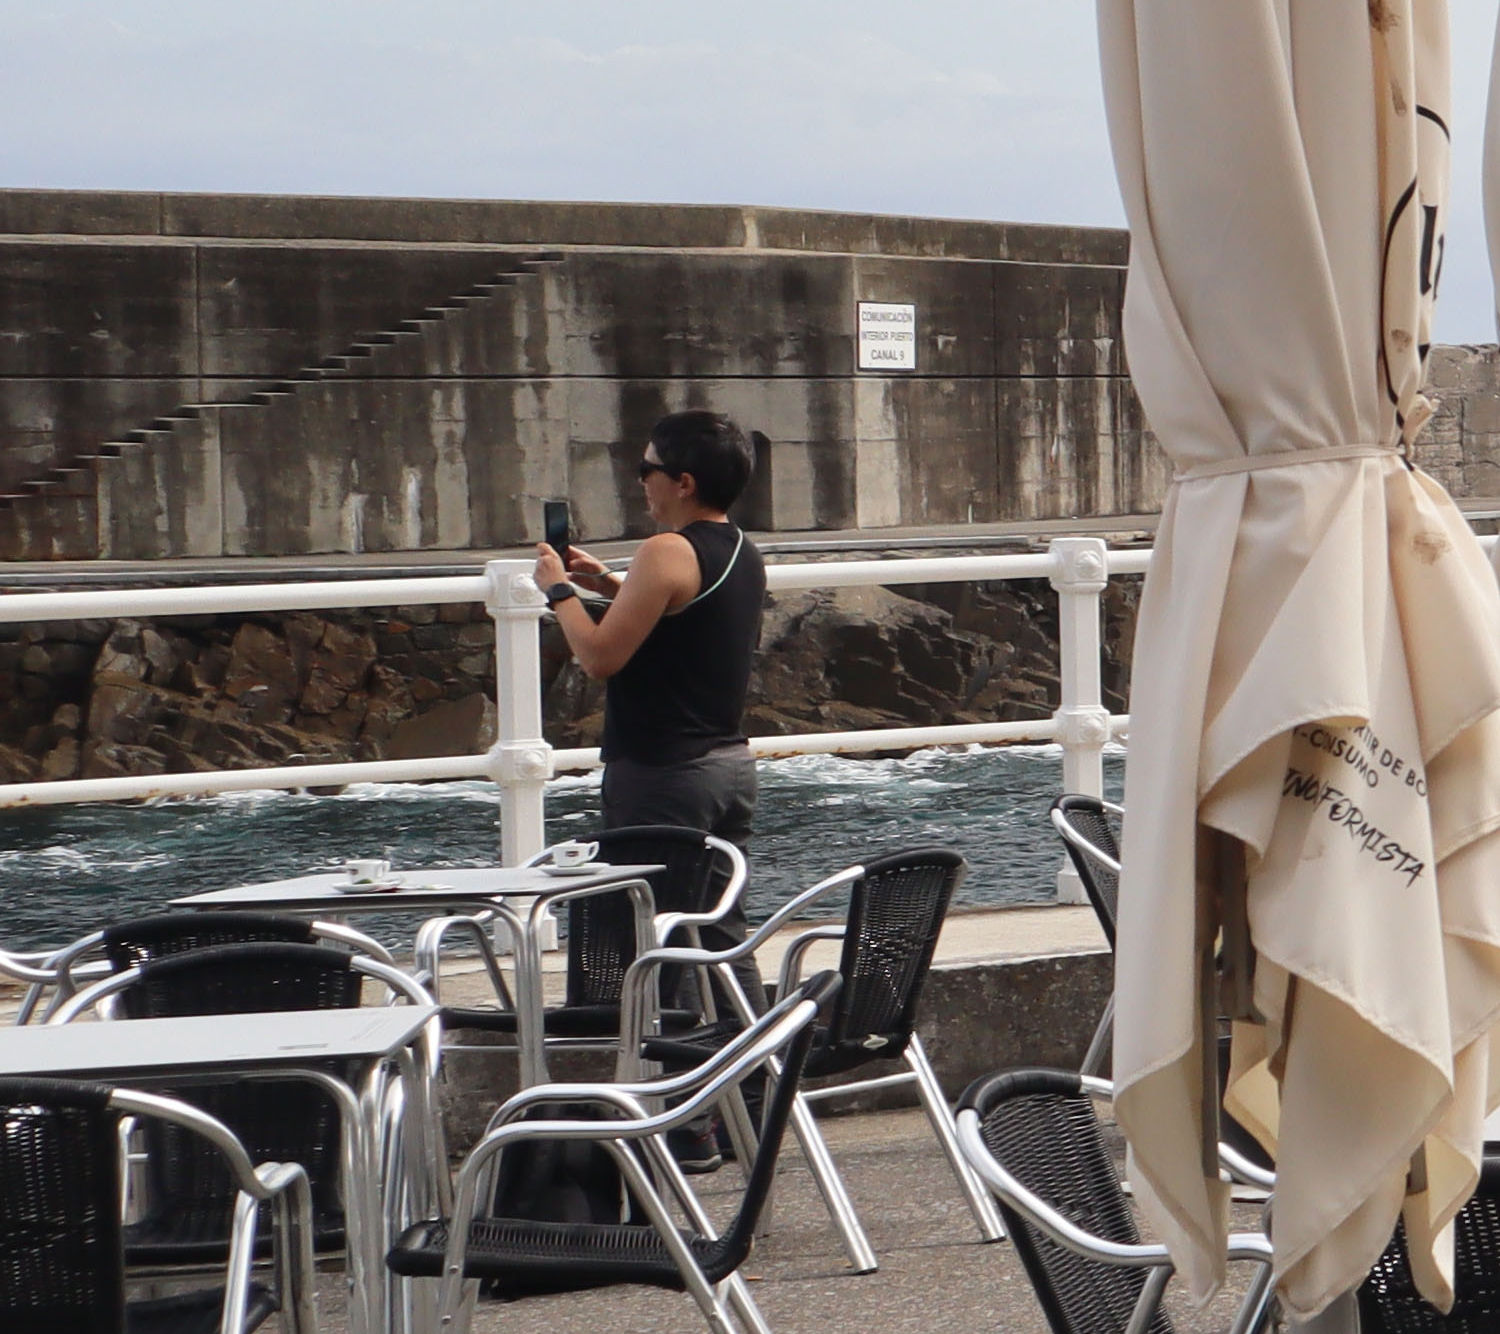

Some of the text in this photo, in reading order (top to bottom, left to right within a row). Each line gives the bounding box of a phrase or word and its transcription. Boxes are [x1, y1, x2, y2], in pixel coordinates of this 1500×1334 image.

[871, 349, 905, 361] CANAL 9
[1380, 749, 1404, 777] DE
